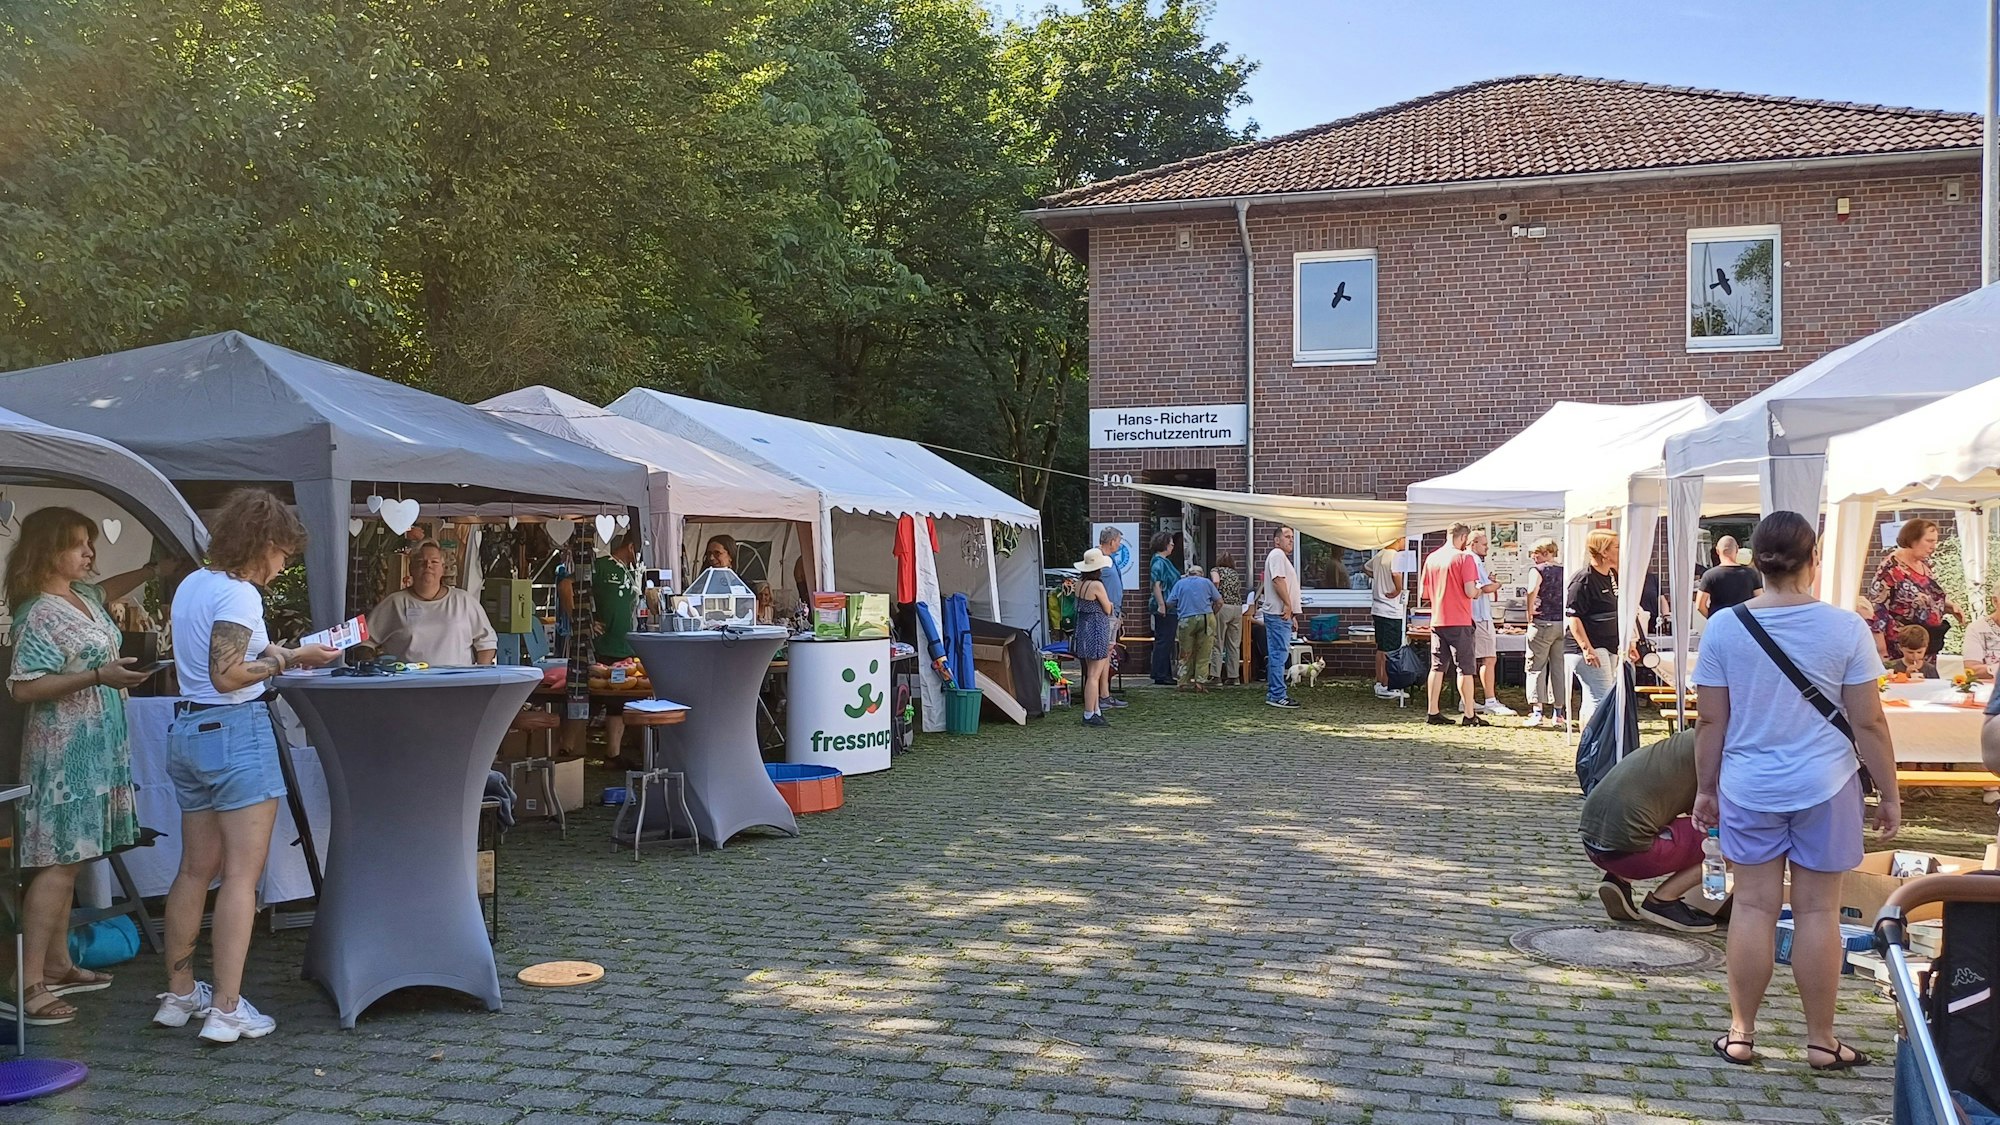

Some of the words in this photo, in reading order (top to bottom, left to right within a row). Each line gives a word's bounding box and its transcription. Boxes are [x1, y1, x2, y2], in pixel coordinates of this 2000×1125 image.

[1118, 412, 1218, 426] Hans-Richartz
[1104, 428, 1232, 441] Tierschutzzentrum
[1103, 474, 1133, 487] 100
